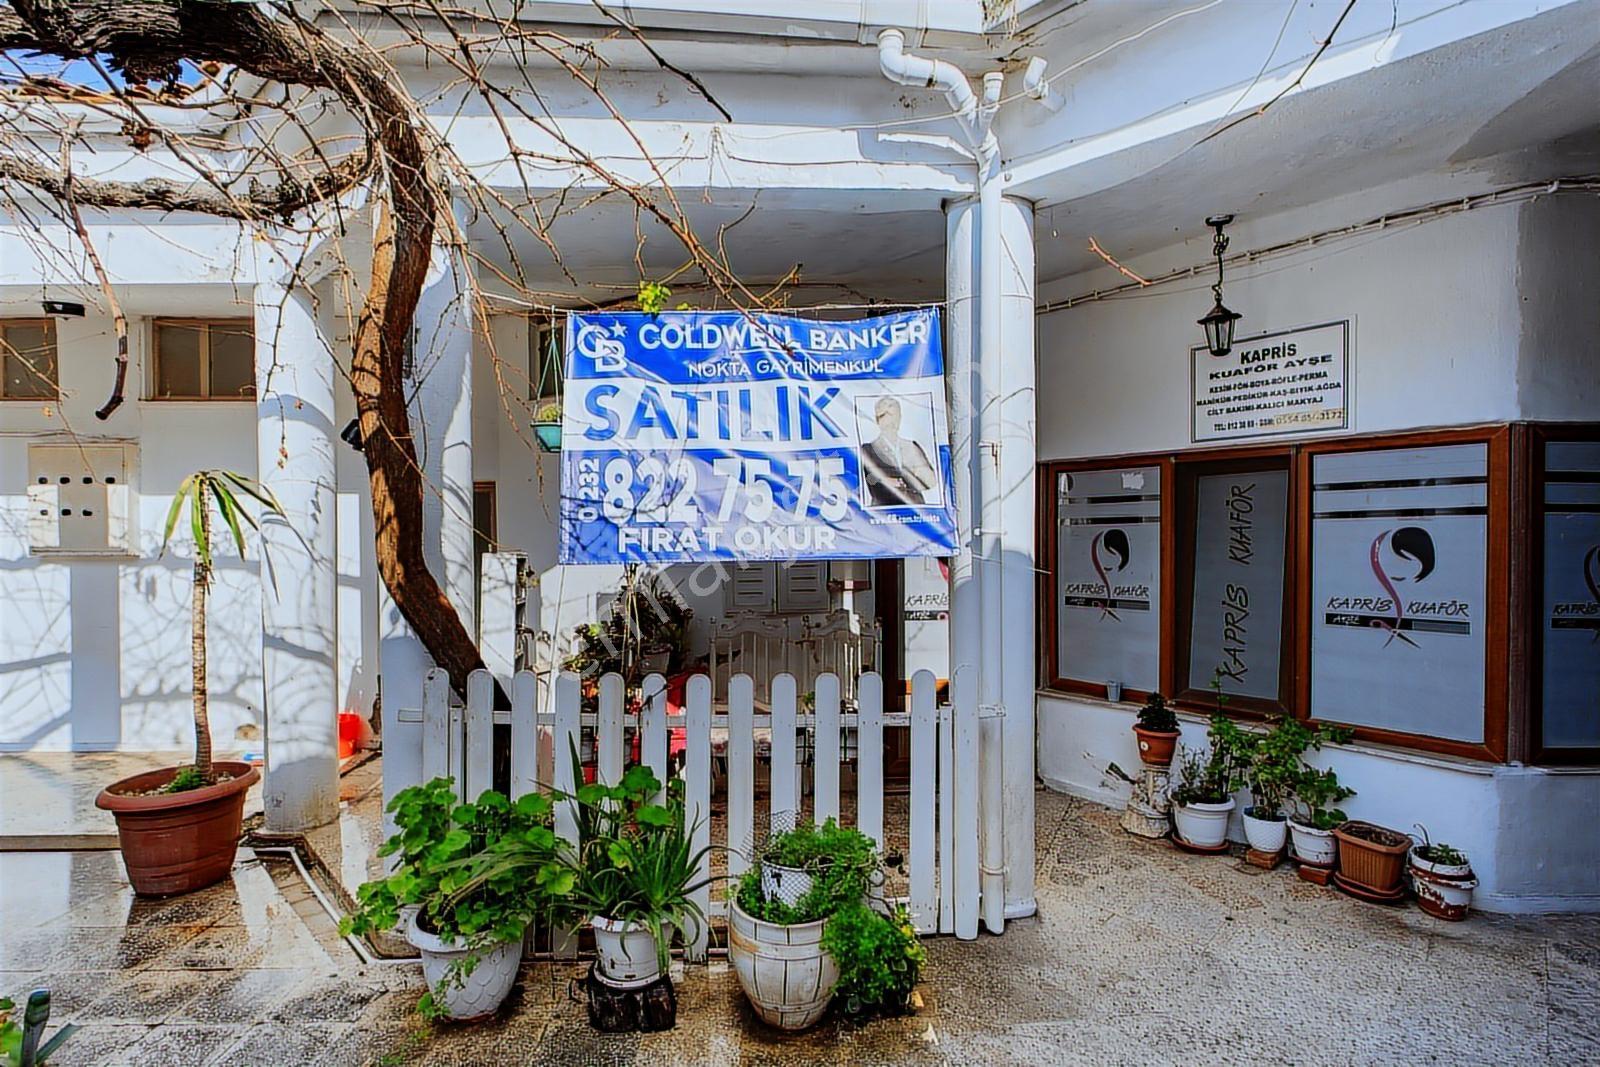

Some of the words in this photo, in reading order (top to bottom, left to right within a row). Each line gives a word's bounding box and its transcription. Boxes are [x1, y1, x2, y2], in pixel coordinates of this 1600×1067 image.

[639, 322, 801, 350] COLDWELL
[810, 319, 928, 351] BANKER
[1209, 363, 1279, 380] KUAFÖR
[1284, 354, 1333, 369] AYŞE
[1240, 342, 1297, 365] KAPRİS
[688, 361, 751, 377] NOKTA
[583, 384, 848, 442] SATILIK
[579, 458, 599, 500] 232
[603, 457, 698, 526] 822
[713, 457, 774, 523] 75
[787, 457, 848, 522] 75
[578, 506, 599, 523] 0
[1229, 484, 1256, 565] KUAFÖR
[619, 526, 723, 553] FIRAT
[735, 526, 836, 551] OKUR
[1327, 597, 1393, 612] KAPRİS
[1407, 600, 1470, 617] KUAFÖR
[1217, 583, 1250, 683] KAPRİS
